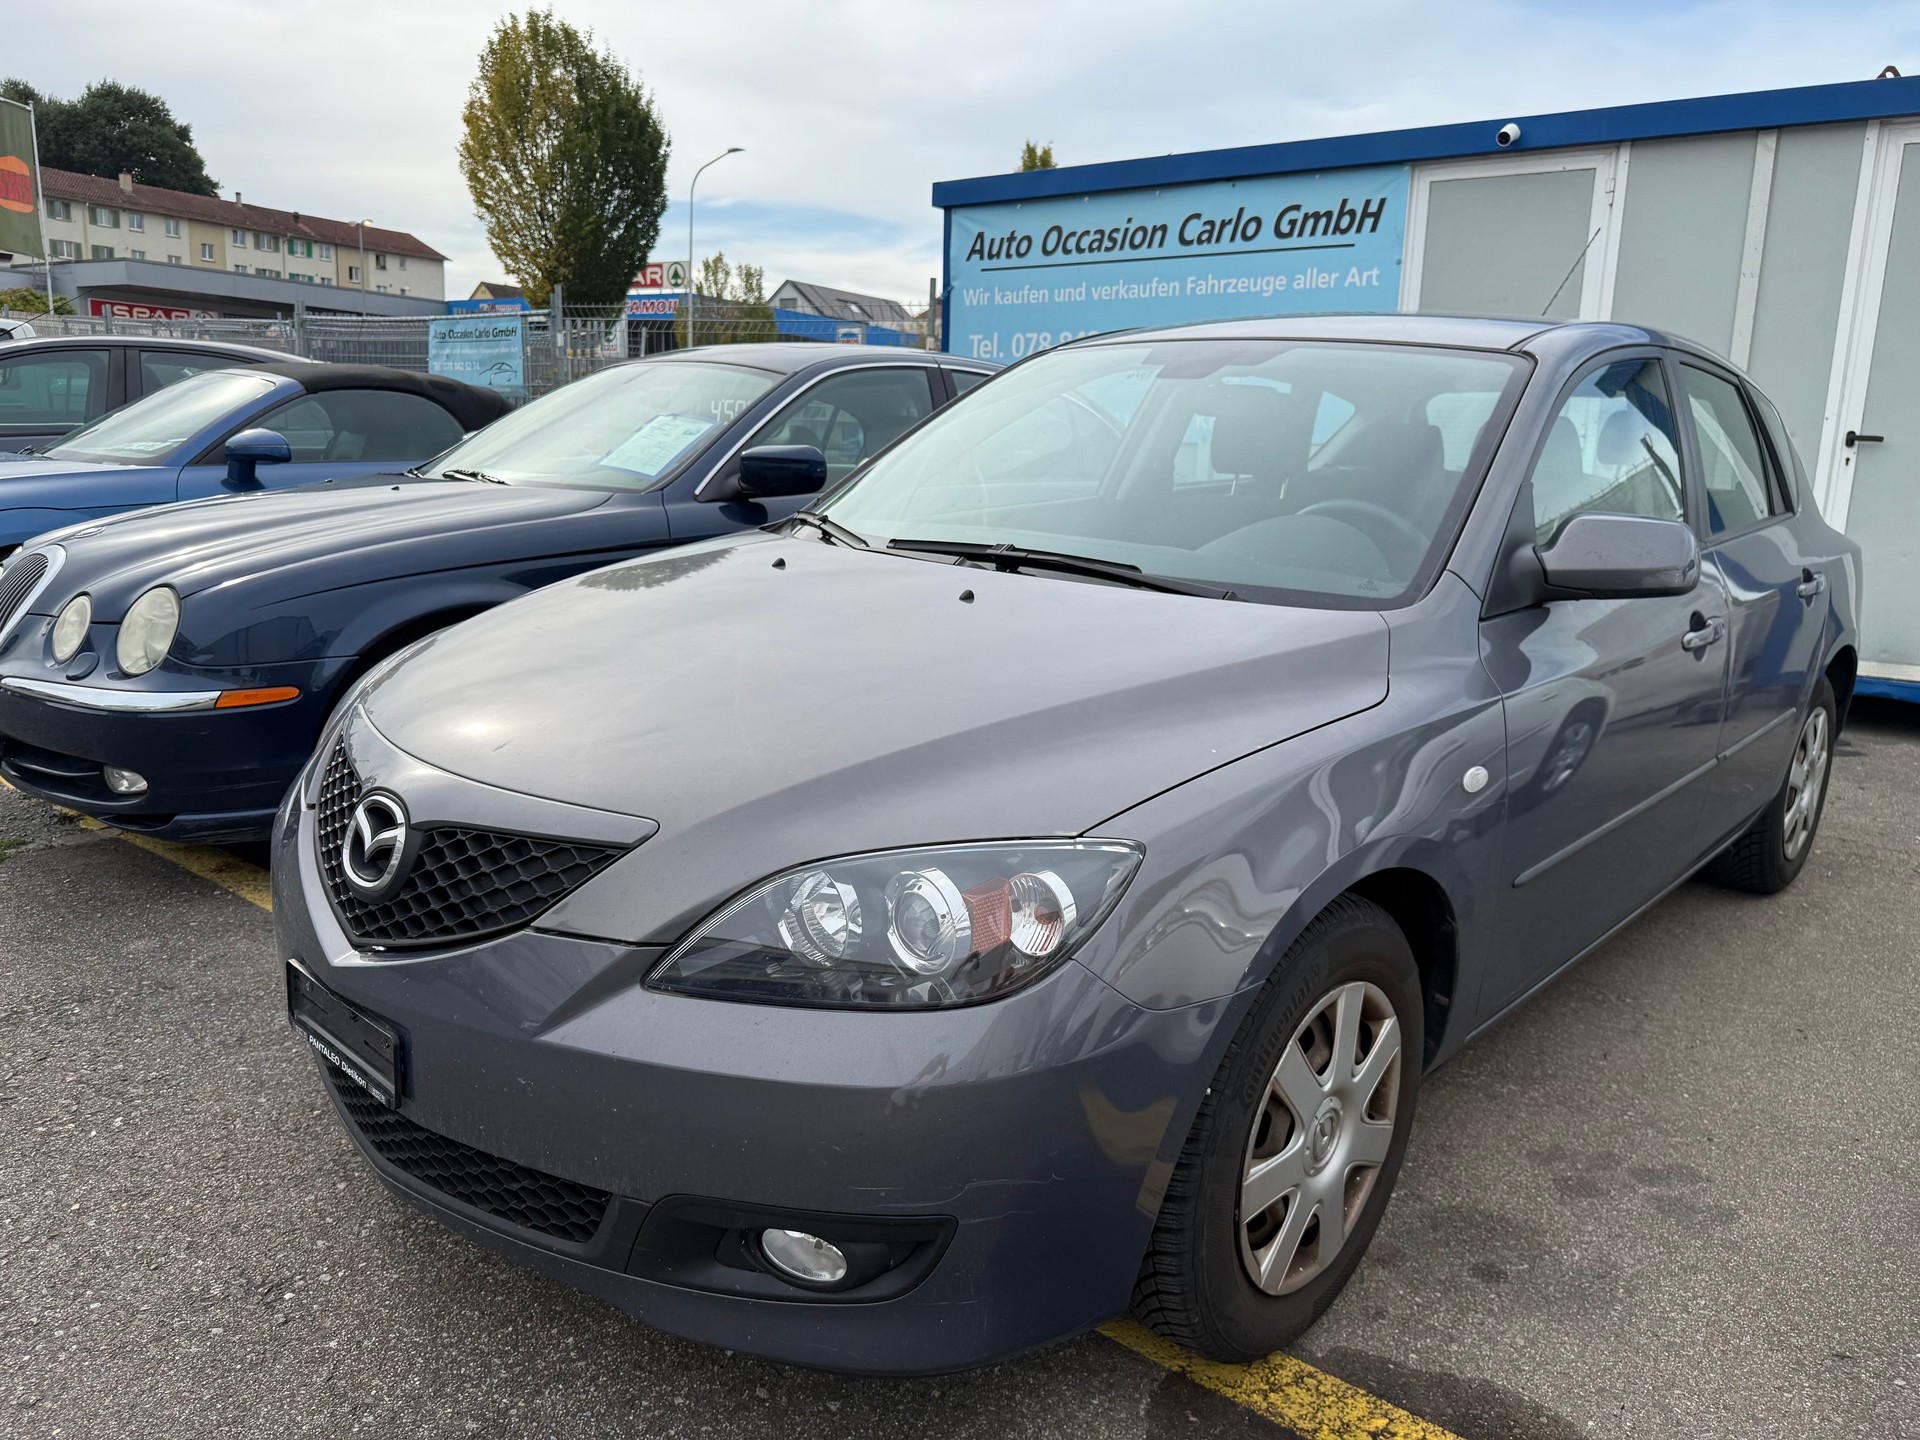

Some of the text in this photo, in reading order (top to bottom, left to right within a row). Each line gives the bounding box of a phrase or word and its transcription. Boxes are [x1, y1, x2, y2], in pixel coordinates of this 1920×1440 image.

[966, 197, 1388, 262] Auto Occasion Carlo GmbH
[963, 266, 1380, 307] Wir kaufen und verkaufen Fahrzeuge aller Art
[448, 327, 474, 340] Occasion
[475, 326, 491, 339] Carlo
[492, 325, 518, 338] GmbH
[968, 331, 1004, 359] Tel.
[309, 1035, 367, 1089] PANTALEO Dietikon
